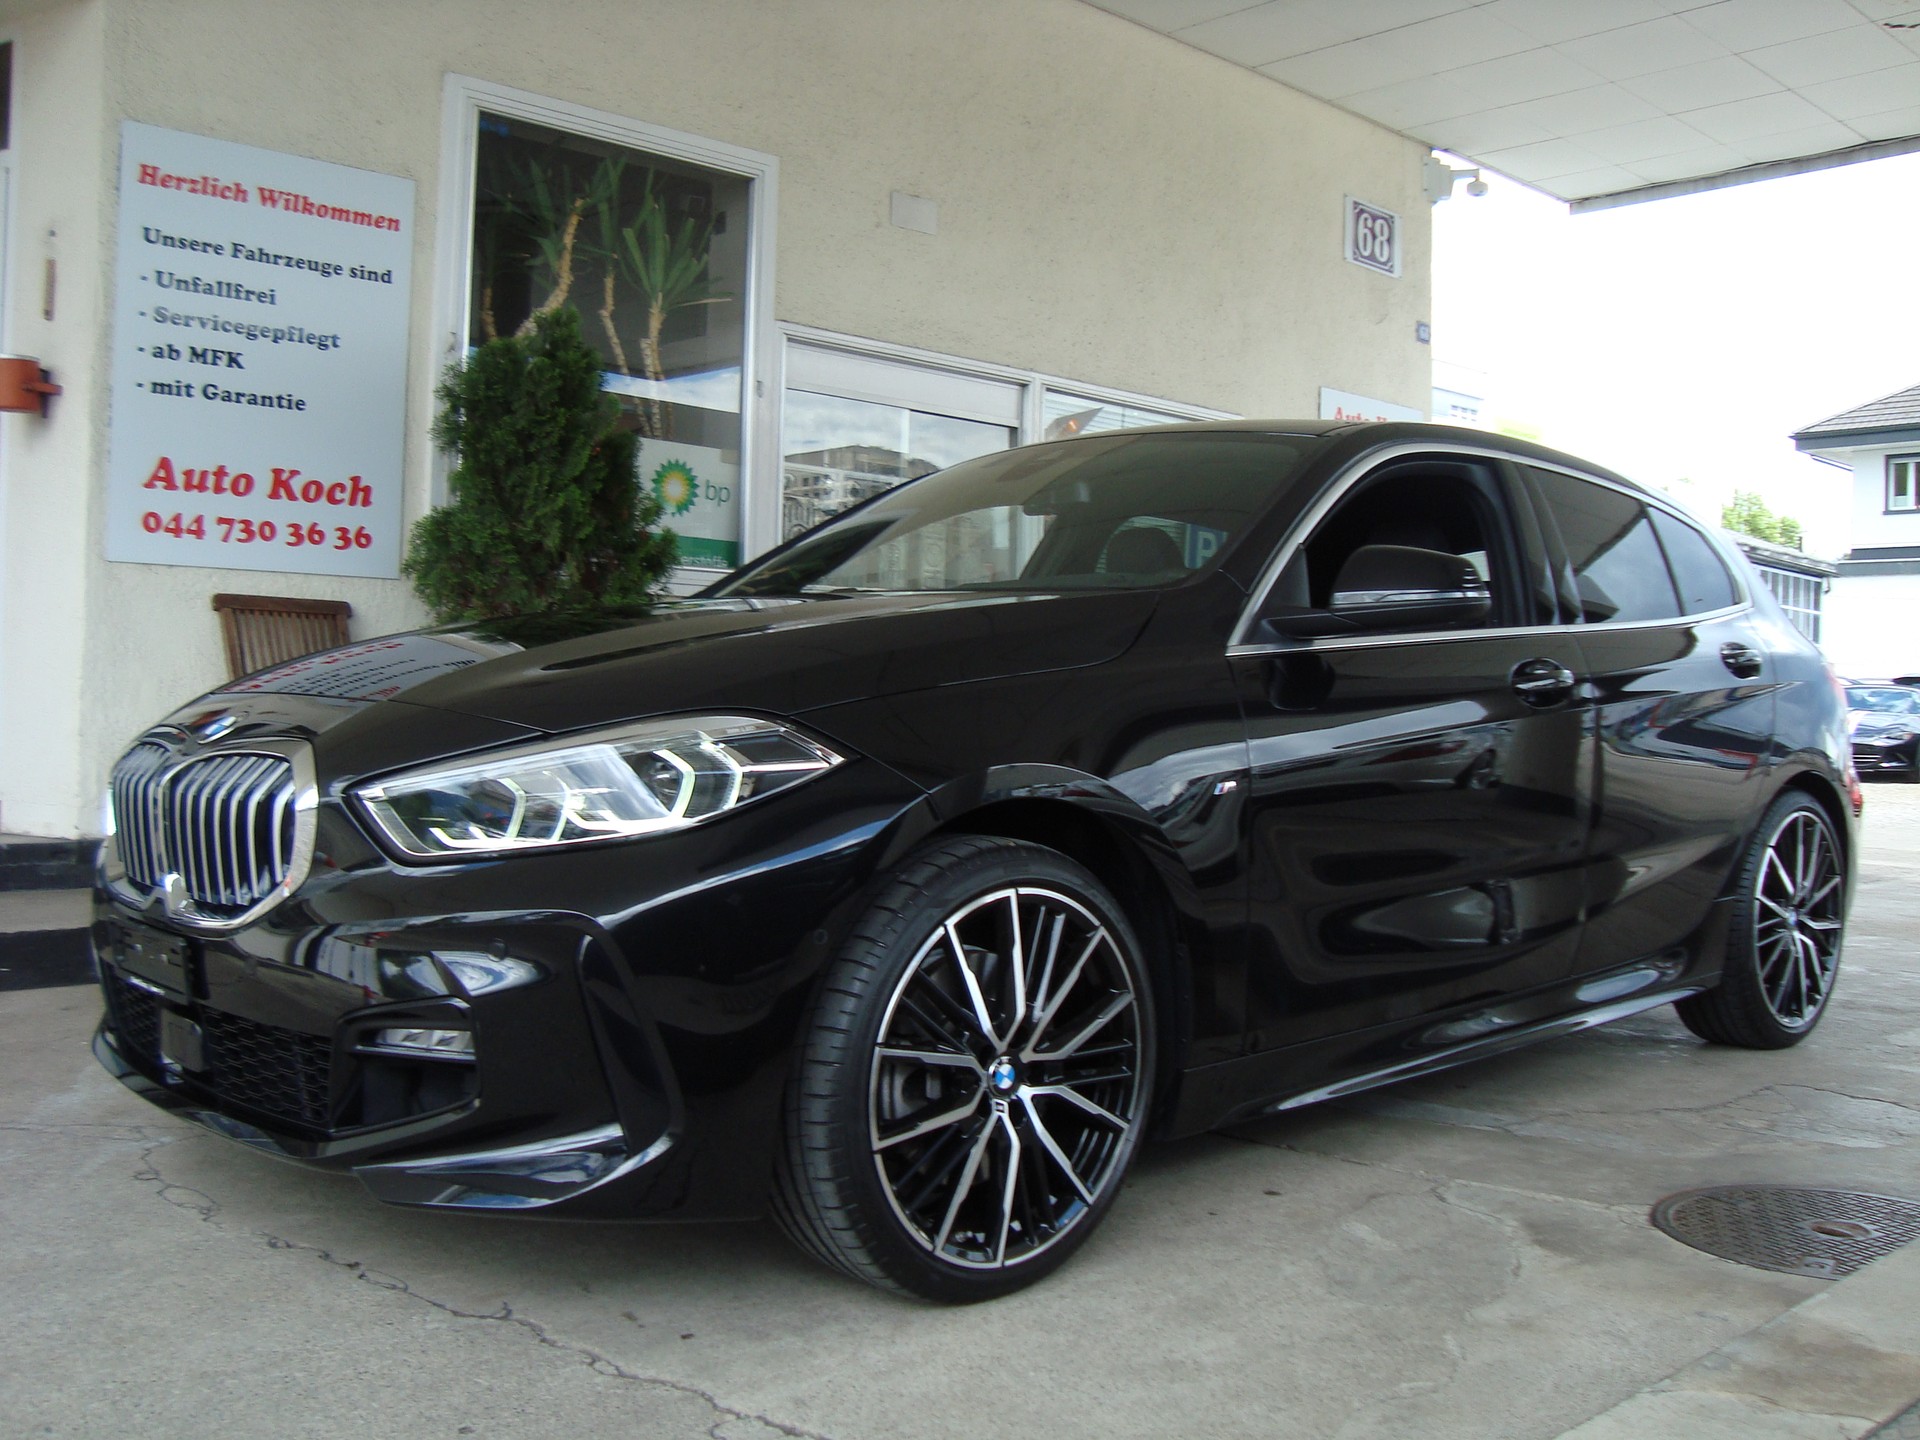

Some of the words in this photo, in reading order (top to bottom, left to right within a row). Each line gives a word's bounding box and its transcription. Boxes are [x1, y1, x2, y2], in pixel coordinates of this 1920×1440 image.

[138, 163, 249, 203] Herzlich
[257, 186, 400, 232] Wilkommen
[142, 226, 225, 256] Unsere
[230, 242, 344, 278] Fahrzeuge
[349, 265, 393, 284] sind
[1356, 212, 1390, 263] 68
[155, 269, 277, 305] Unfallfrei
[153, 306, 340, 351] Servicegepflegt
[152, 344, 181, 361] ab
[188, 345, 246, 369] MFK
[150, 380, 195, 398] mit
[202, 383, 307, 411] Garantie
[142, 456, 255, 497] Auto
[267, 467, 373, 507] Koch
[704, 479, 731, 507] bp
[142, 511, 206, 540] 044
[216, 516, 277, 543] 730
[285, 522, 326, 547] 36
[333, 525, 373, 550] 36
[1196, 530, 1217, 569] P
